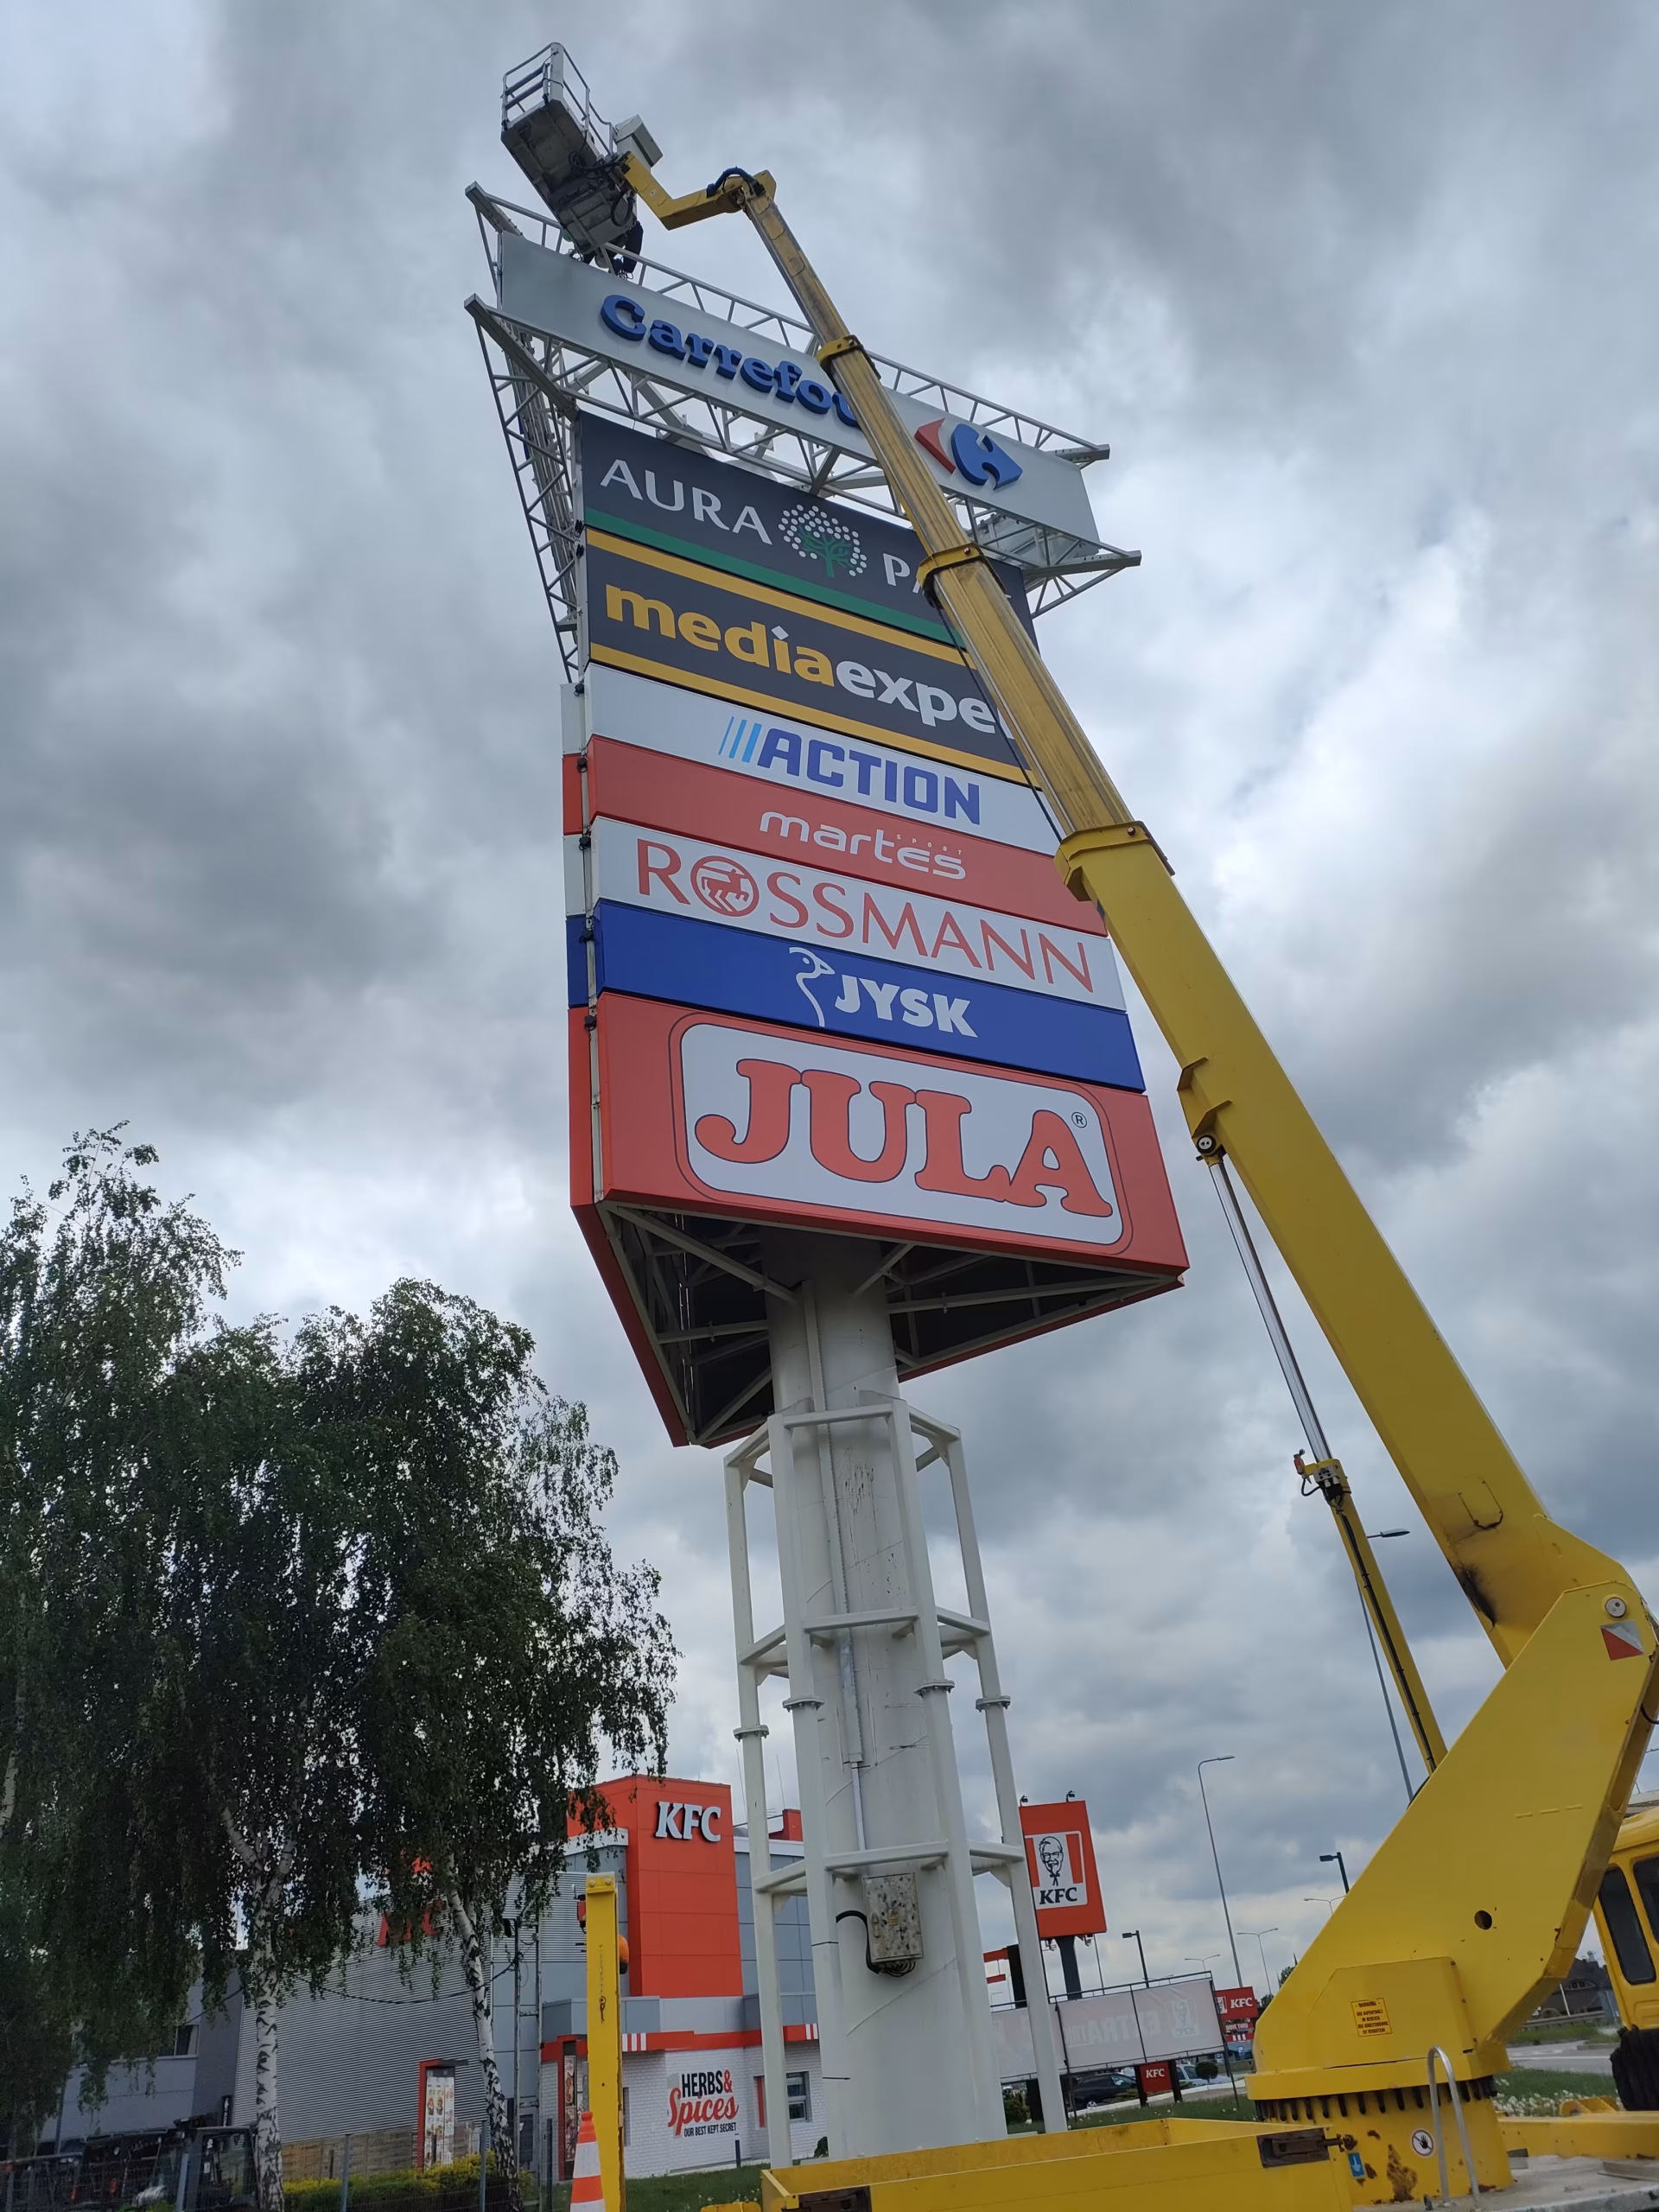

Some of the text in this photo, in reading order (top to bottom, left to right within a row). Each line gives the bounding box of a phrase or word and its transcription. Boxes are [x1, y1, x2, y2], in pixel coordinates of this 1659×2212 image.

[601, 294, 861, 429] Carrefou
[601, 459, 772, 545] AURA
[605, 583, 1014, 740] mediaexpe
[756, 728, 980, 825] ACTION
[760, 810, 966, 880] martes
[636, 838, 1094, 993] ROSSMANN
[835, 975, 979, 1038] JYSK
[694, 1058, 1113, 1217] JULA
[655, 1801, 721, 1842] KFC
[1039, 1886, 1077, 1905] KFC
[1230, 1997, 1253, 2009] KFC
[1145, 2069, 1165, 2078] KFC
[668, 2088, 739, 2136] Spices
[683, 2122, 736, 2137] OUR BEST KEPT SECRET
